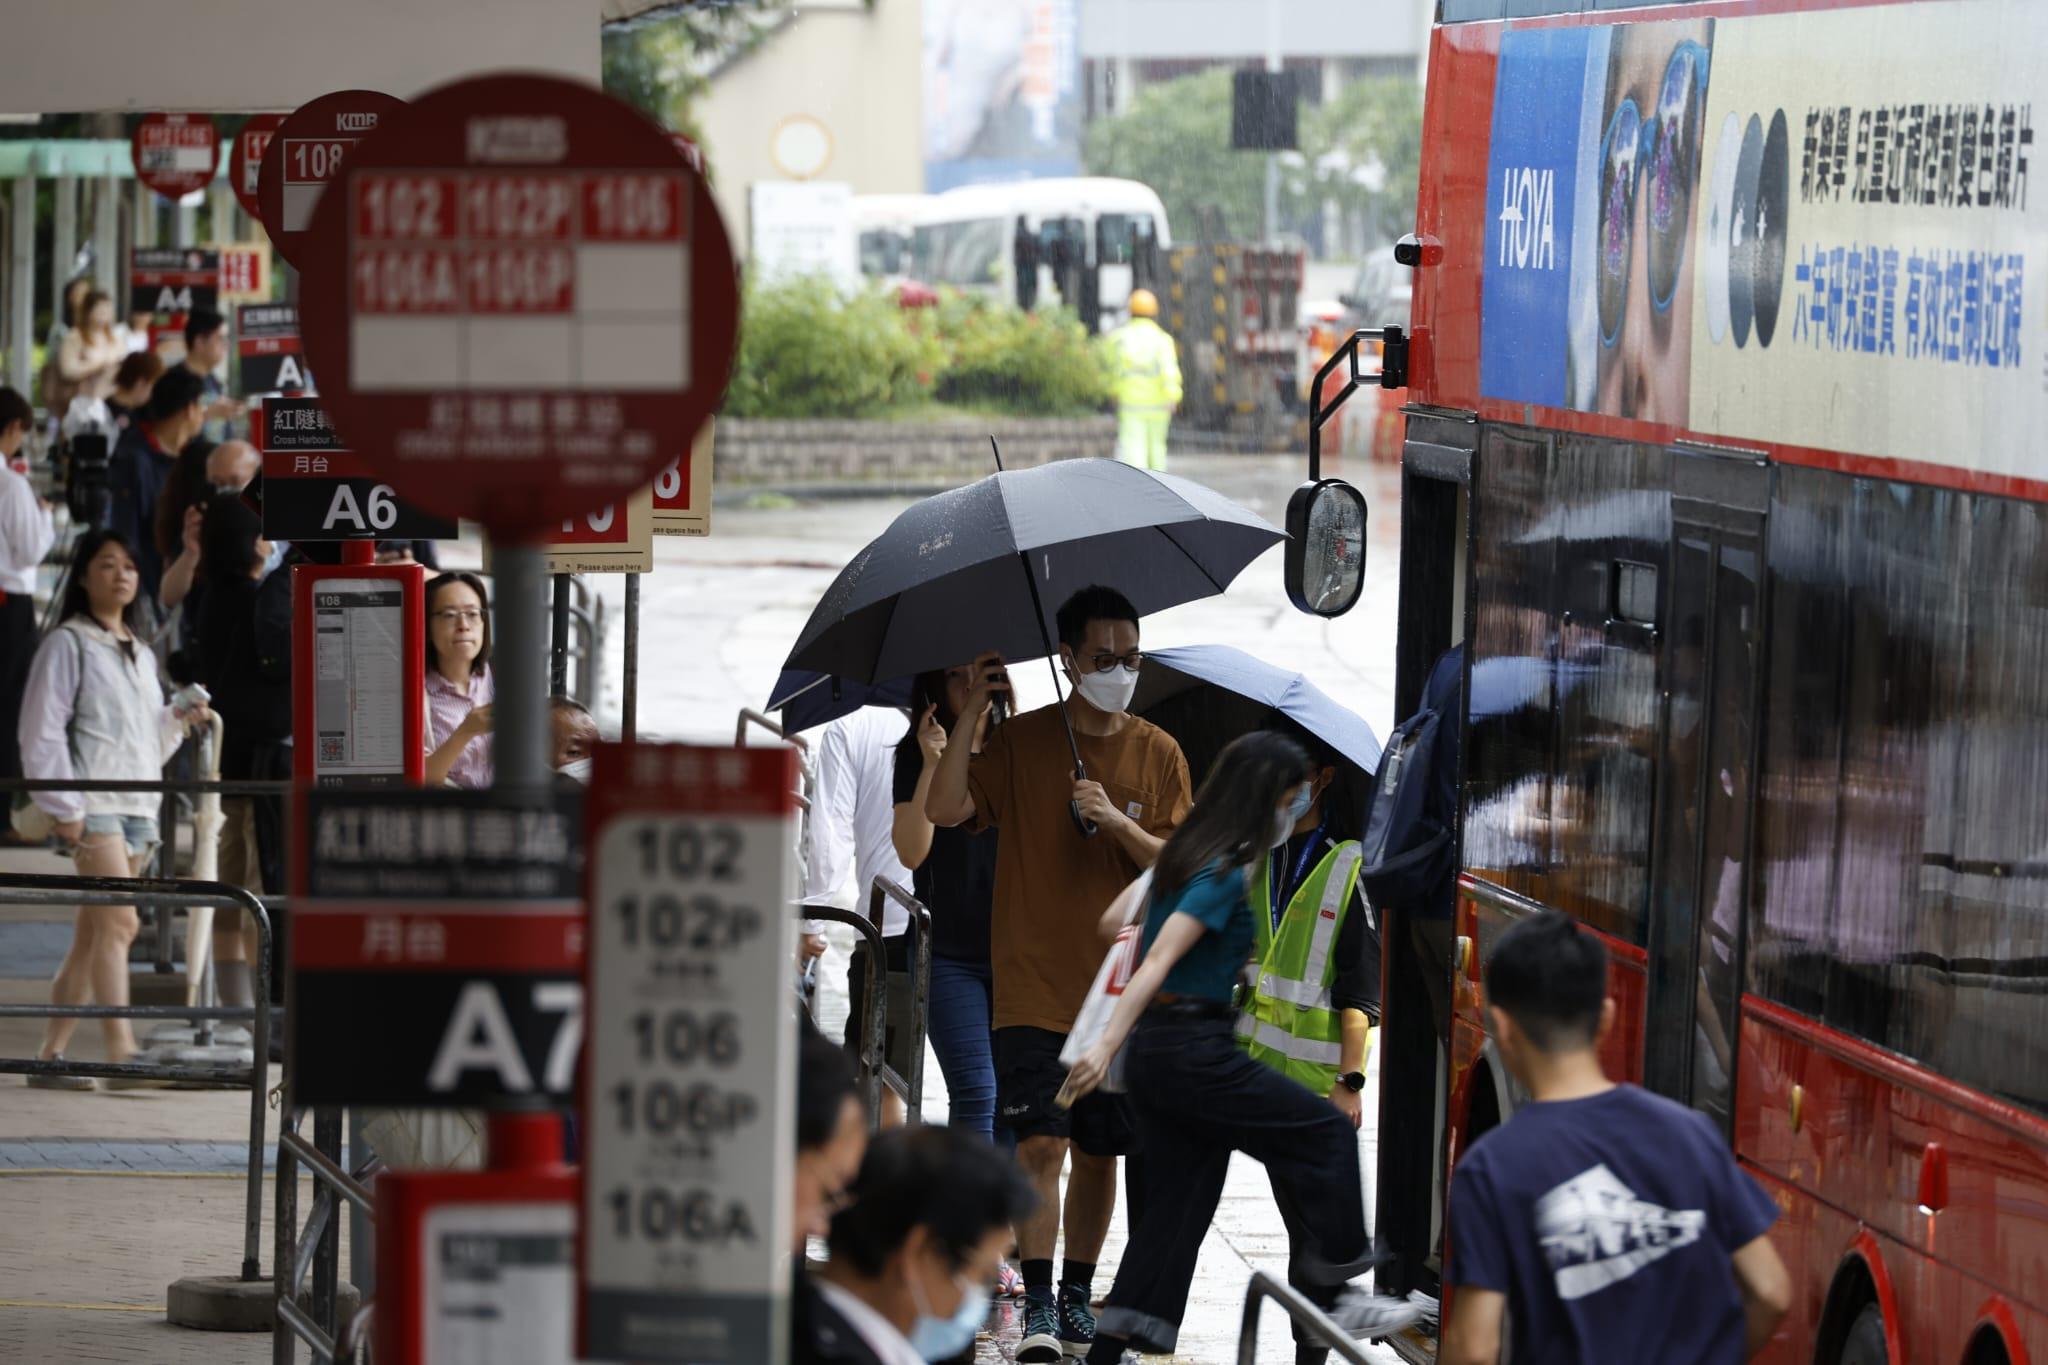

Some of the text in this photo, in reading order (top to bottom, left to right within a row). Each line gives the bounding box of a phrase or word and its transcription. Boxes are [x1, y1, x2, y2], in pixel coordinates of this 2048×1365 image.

[336, 113, 378, 131] KMB
[295, 144, 343, 178] 108
[367, 177, 441, 234] 102
[1499, 167, 1554, 270] HOYA
[156, 285, 193, 312] A4
[273, 435, 297, 445] Cross
[294, 456, 329, 473] 月台
[322, 484, 398, 530] A6
[320, 595, 342, 606] 108
[632, 825, 746, 883] 102
[611, 893, 765, 951] 102P
[427, 978, 585, 1094] A7
[629, 1008, 744, 1071] 106
[608, 1077, 761, 1140] 106P
[604, 1185, 761, 1249] 106A
